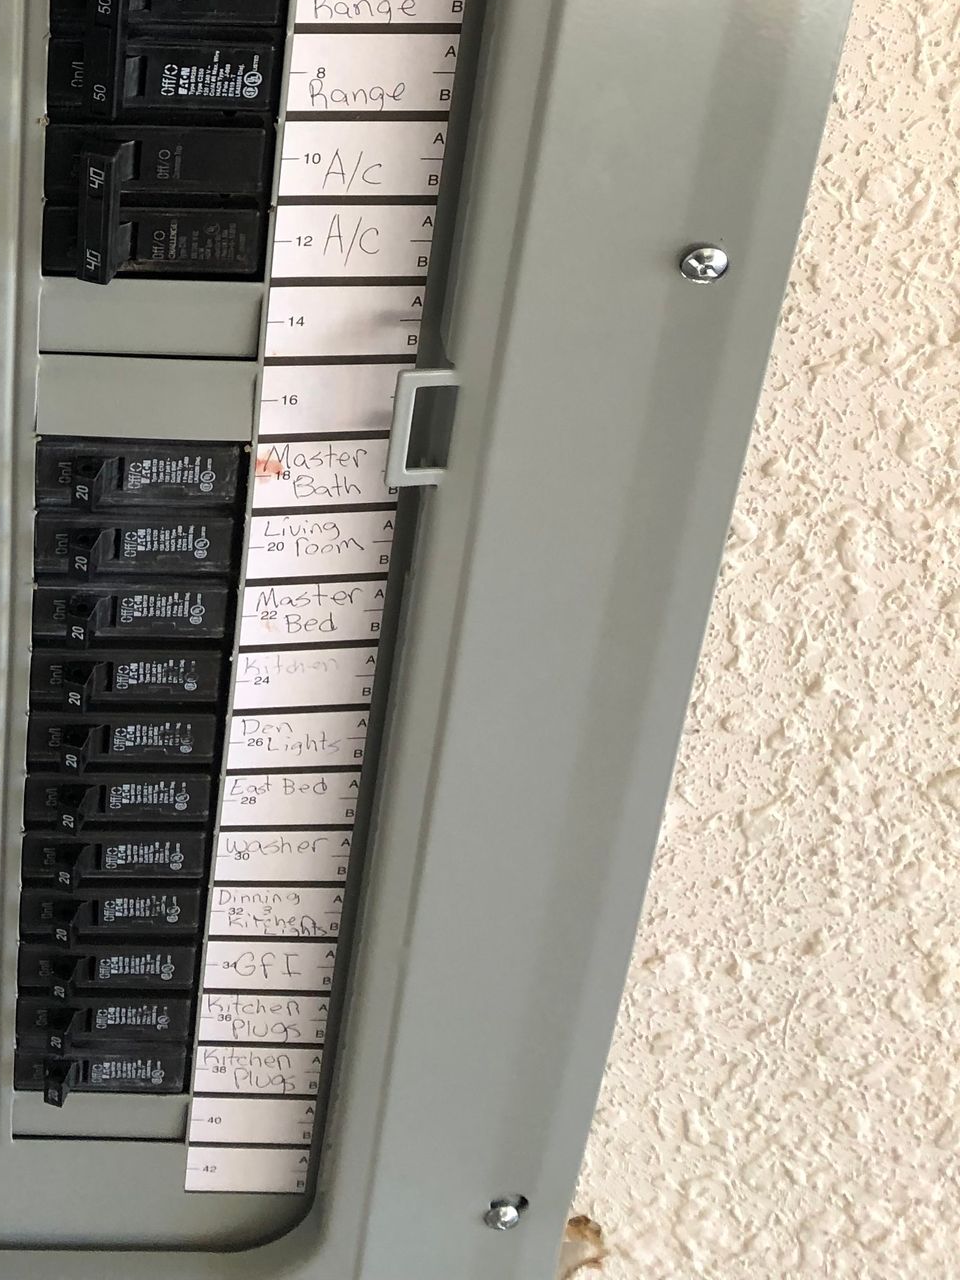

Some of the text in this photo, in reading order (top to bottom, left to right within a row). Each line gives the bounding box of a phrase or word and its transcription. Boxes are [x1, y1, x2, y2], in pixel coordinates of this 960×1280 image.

[316, 67, 326, 79] 8
[93, 84, 107, 103] 50
[308, 78, 406, 113] Range
[304, 153, 321, 165] 10
[88, 167, 106, 190] 40
[322, 147, 383, 193] A/C
[295, 235, 313, 247] 12
[323, 213, 380, 267] A/C
[85, 247, 102, 271] 40
[288, 316, 305, 327] 14
[281, 395, 298, 406] 16
[262, 443, 368, 472] Master
[276, 470, 291, 481] 18
[292, 473, 363, 499] Bath
[263, 516, 342, 539] Living
[267, 542, 284, 552] 20
[256, 583, 365, 610] Master
[260, 611, 277, 620] 22
[284, 612, 338, 634] Bed
[242, 655, 340, 677] Kitchen
[253, 676, 270, 685] 24
[241, 718, 293, 737] Den
[247, 738, 263, 747] 26
[267, 733, 341, 754] Lights
[230, 776, 327, 796] East Bed
[219, 890, 300, 905] Dinning
[222, 961, 236, 969] 34
[207, 994, 302, 1016] Kitchen
[217, 1014, 232, 1022] 36
[231, 1019, 301, 1042] Plugs
[203, 1048, 291, 1068] Kitchen
[211, 1066, 227, 1074] 38
[233, 1069, 296, 1094] Plugs
[207, 1116, 222, 1125] 40
[202, 1165, 217, 1174] 42
